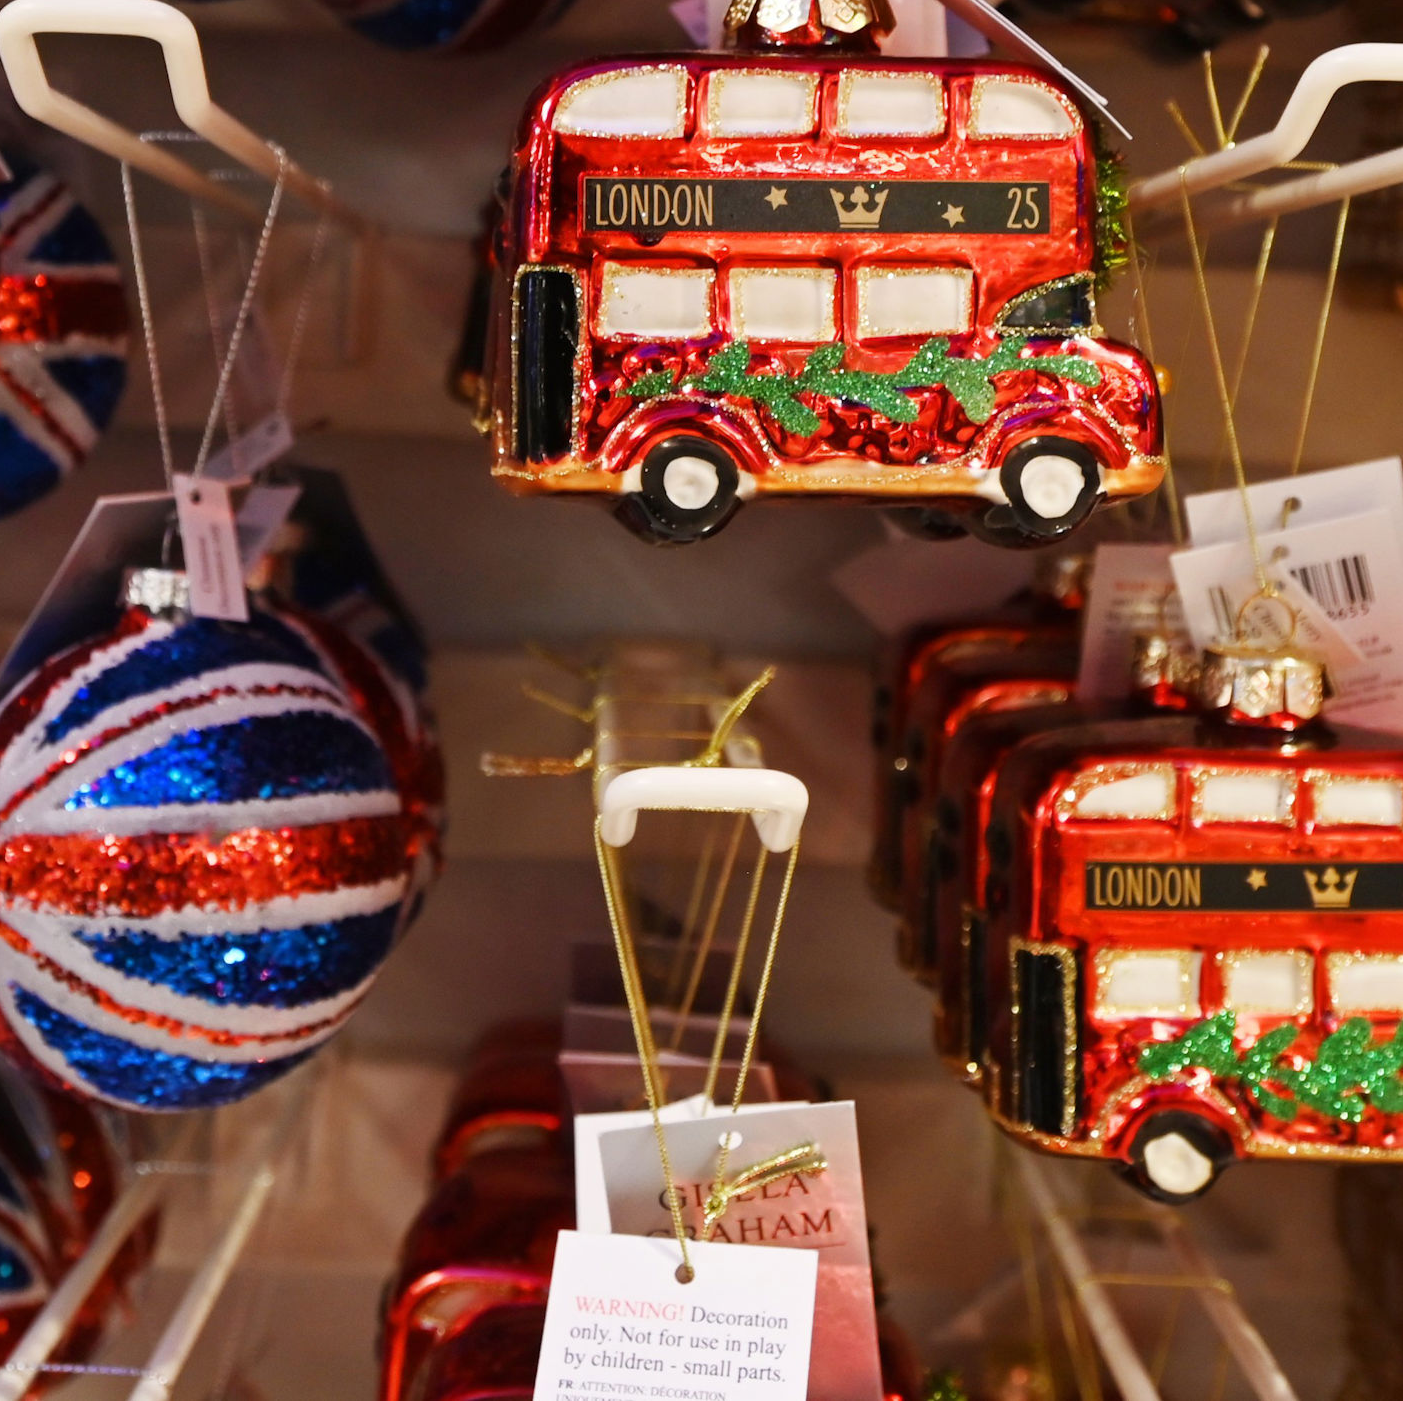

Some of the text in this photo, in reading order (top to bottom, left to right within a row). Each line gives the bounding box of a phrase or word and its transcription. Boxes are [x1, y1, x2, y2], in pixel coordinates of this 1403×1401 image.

[595, 182, 1041, 230] LONDON 25
[1093, 864, 1202, 908] LONDON
[575, 1295, 788, 1331] WARNING! Decoration
[569, 1322, 787, 1361] only. Not for use in play
[563, 1346, 586, 1370] by
[591, 1349, 664, 1373] children
[682, 1359, 732, 1379] small
[736, 1363, 787, 1384] parts.
